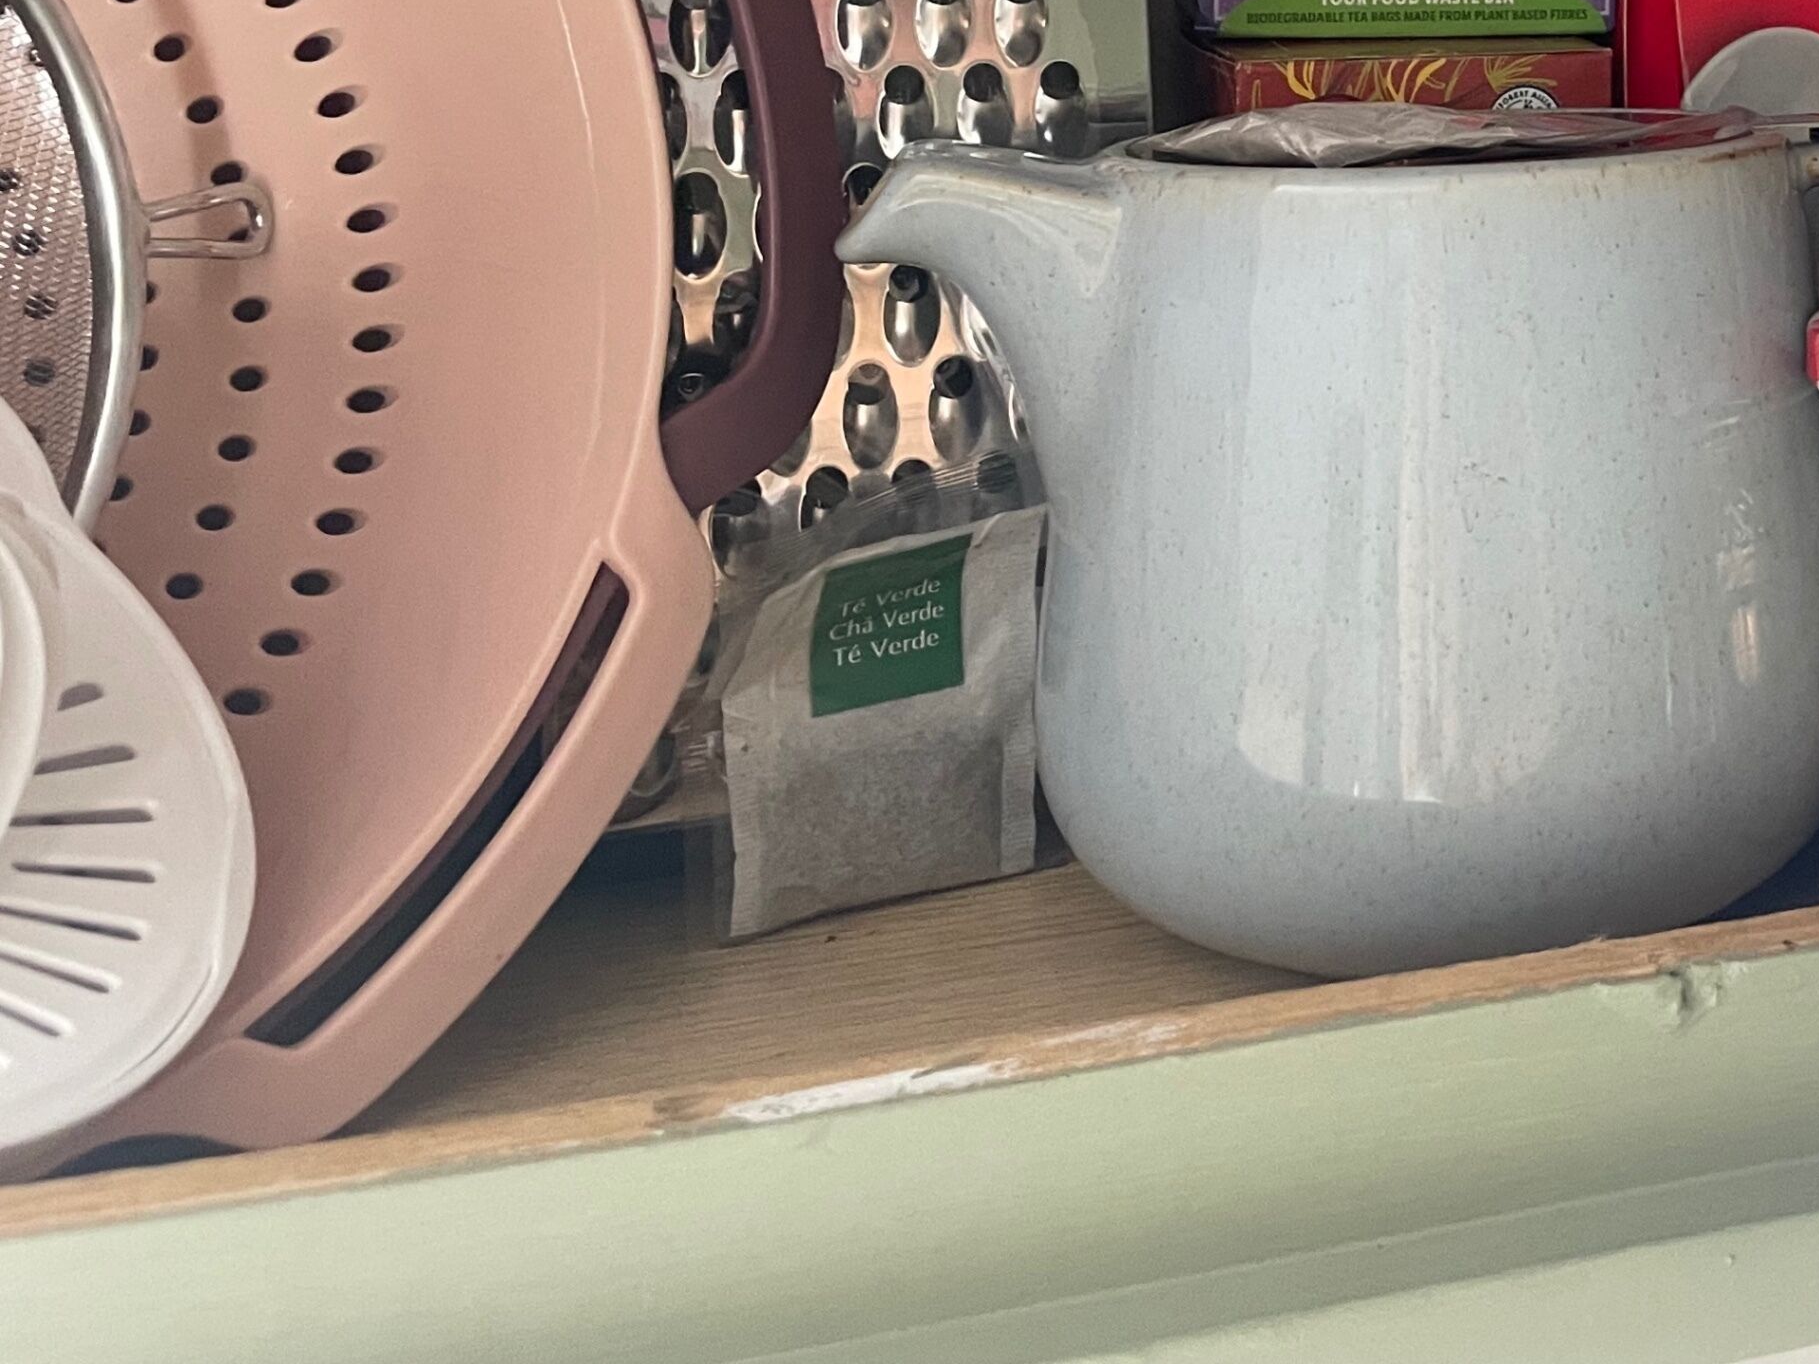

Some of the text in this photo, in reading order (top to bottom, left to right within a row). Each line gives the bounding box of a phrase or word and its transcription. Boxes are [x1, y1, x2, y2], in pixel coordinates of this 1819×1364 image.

[1246, 11, 1345, 25] BIODEGRADABLE
[1348, 11, 1368, 23] TEA
[1371, 11, 1401, 23] BAGS
[1403, 10, 1436, 23] MADE
[1439, 10, 1472, 22] FROM
[1474, 10, 1511, 22] PLANT
[1512, 9, 1548, 21] BASED
[1495, 89, 1529, 110] FOREST
[841, 577, 942, 617] Té Verde
[882, 602, 945, 629] Verde
[832, 630, 940, 667] Té Verde
